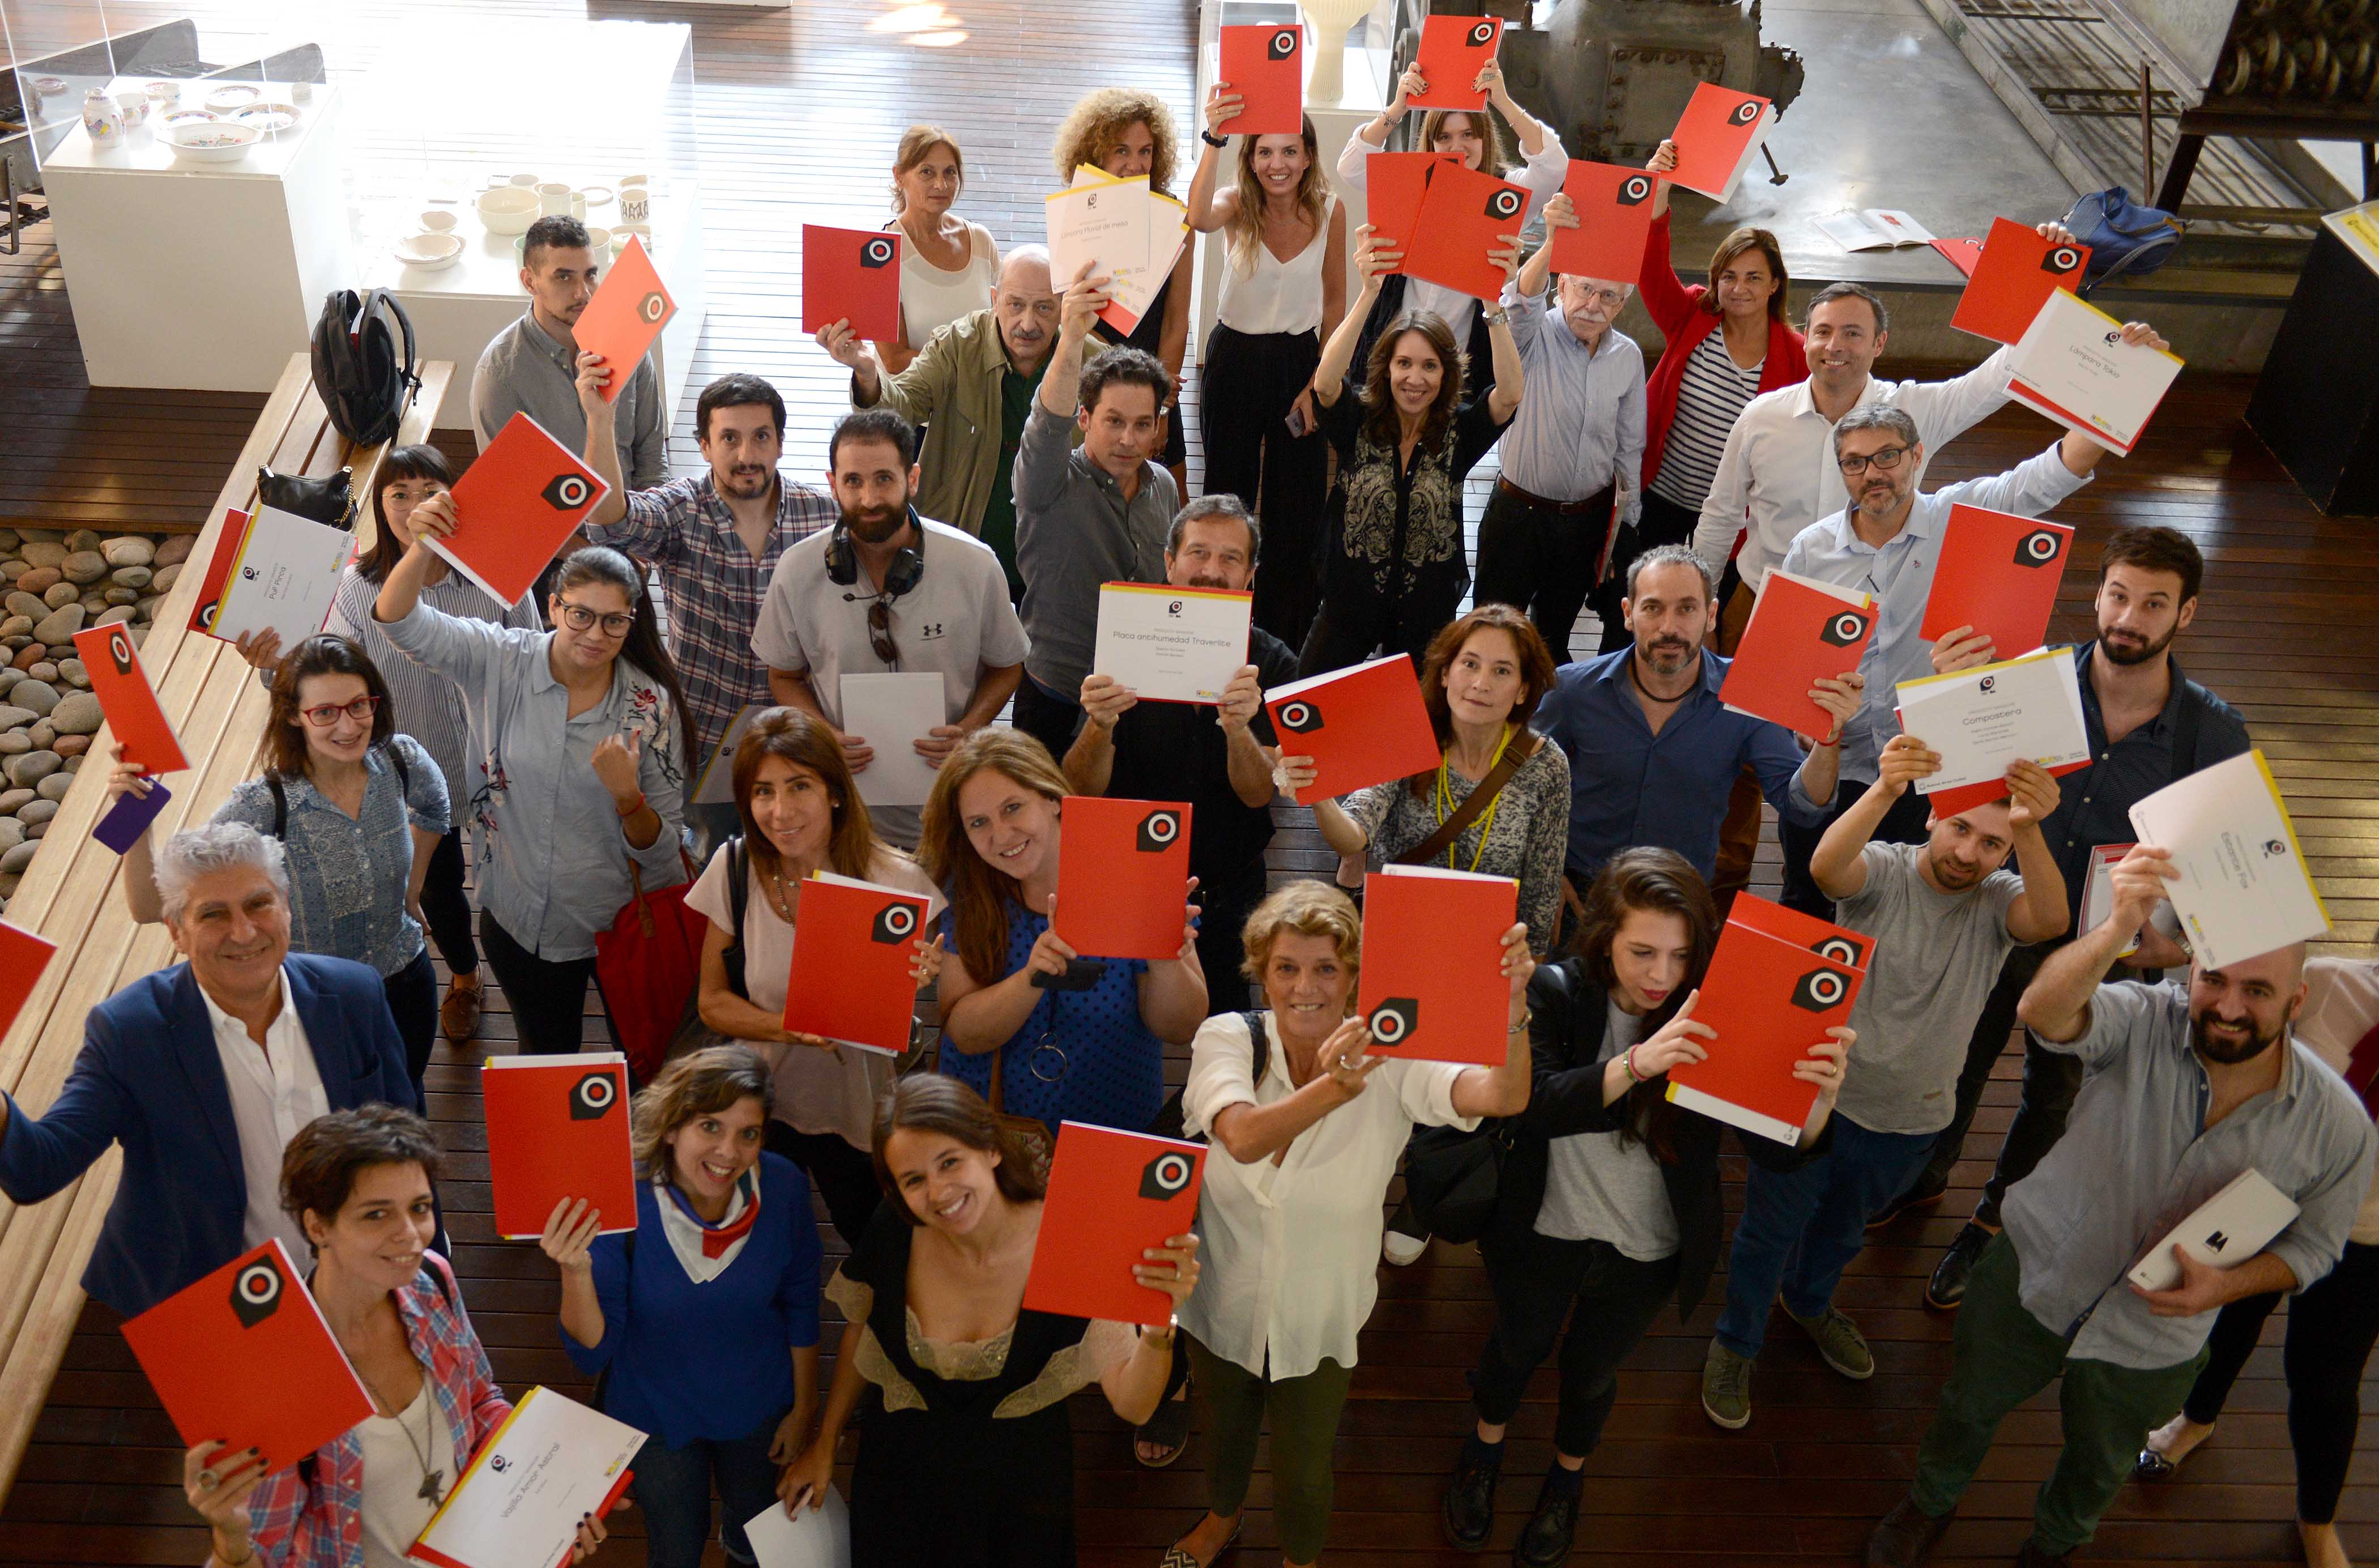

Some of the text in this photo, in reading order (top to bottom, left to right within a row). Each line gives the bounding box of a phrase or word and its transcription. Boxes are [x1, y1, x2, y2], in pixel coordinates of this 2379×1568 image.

[1112, 630, 1135, 640] Placa
[1136, 633, 1191, 644] antihumedad
[1962, 708, 2022, 726] Compostera
[500, 1494, 523, 1518] Vajilla
[520, 1470, 539, 1494] Amor
